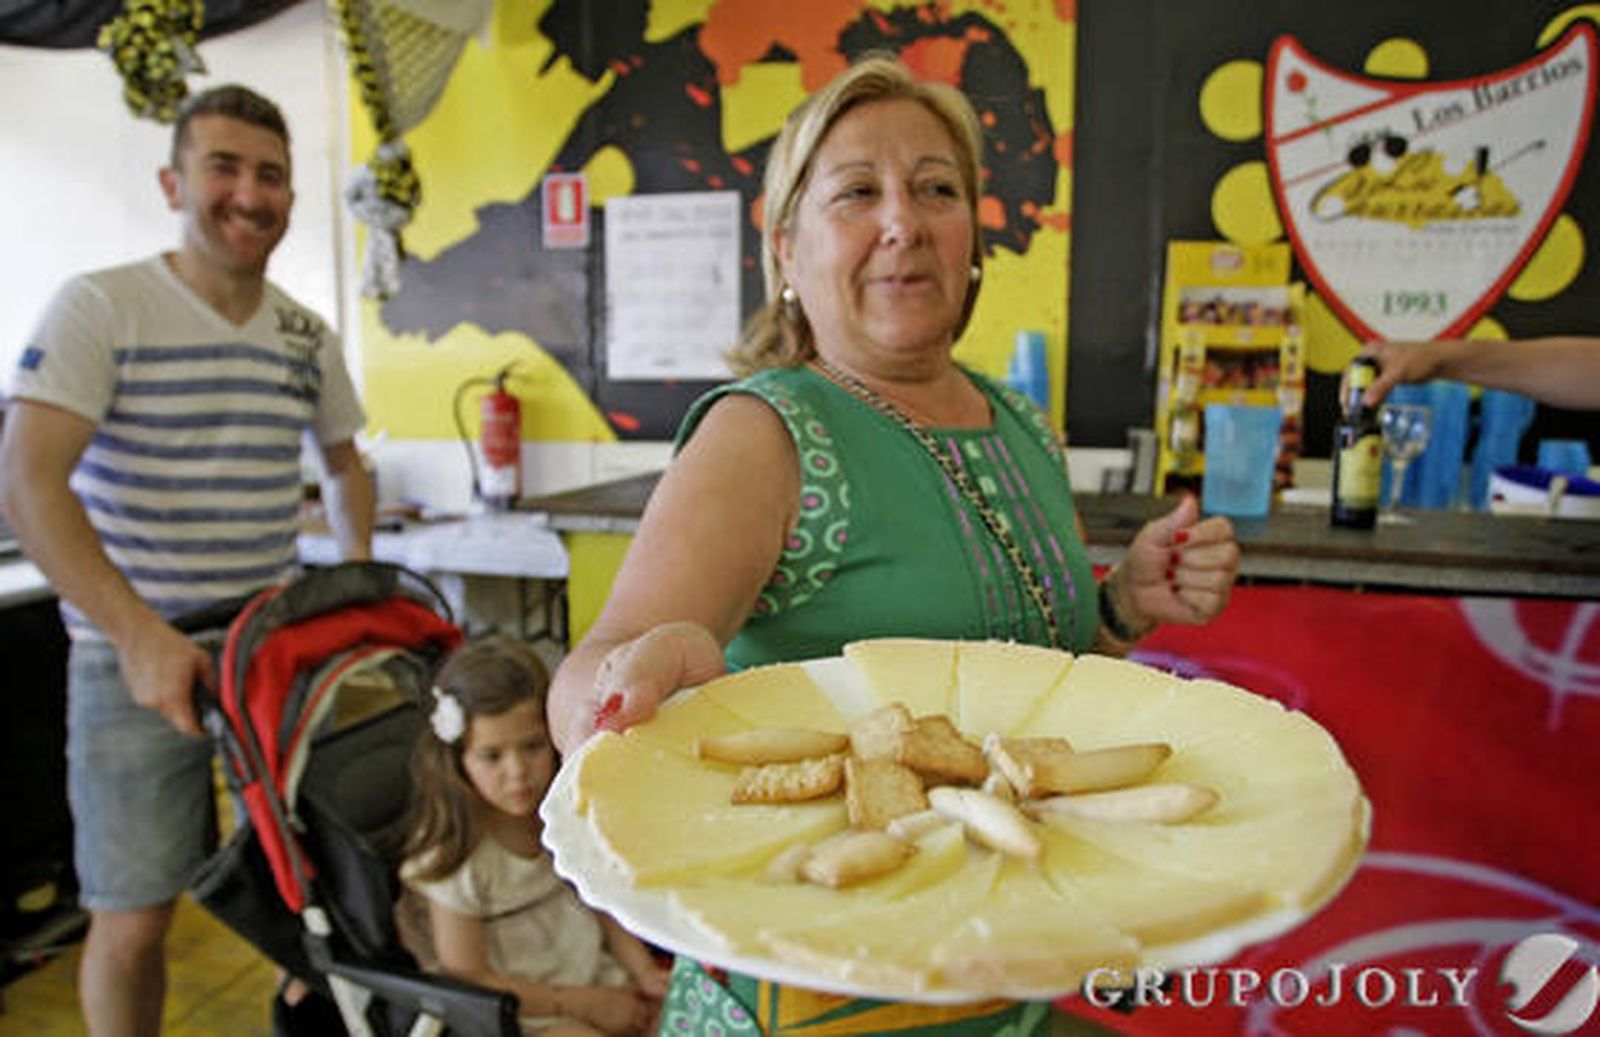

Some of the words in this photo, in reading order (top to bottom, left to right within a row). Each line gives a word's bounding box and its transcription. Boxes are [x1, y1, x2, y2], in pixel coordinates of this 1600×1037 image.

[1411, 105, 1466, 133] Los
[1472, 57, 1584, 112] Barrios
[1380, 290, 1447, 316] 1993
